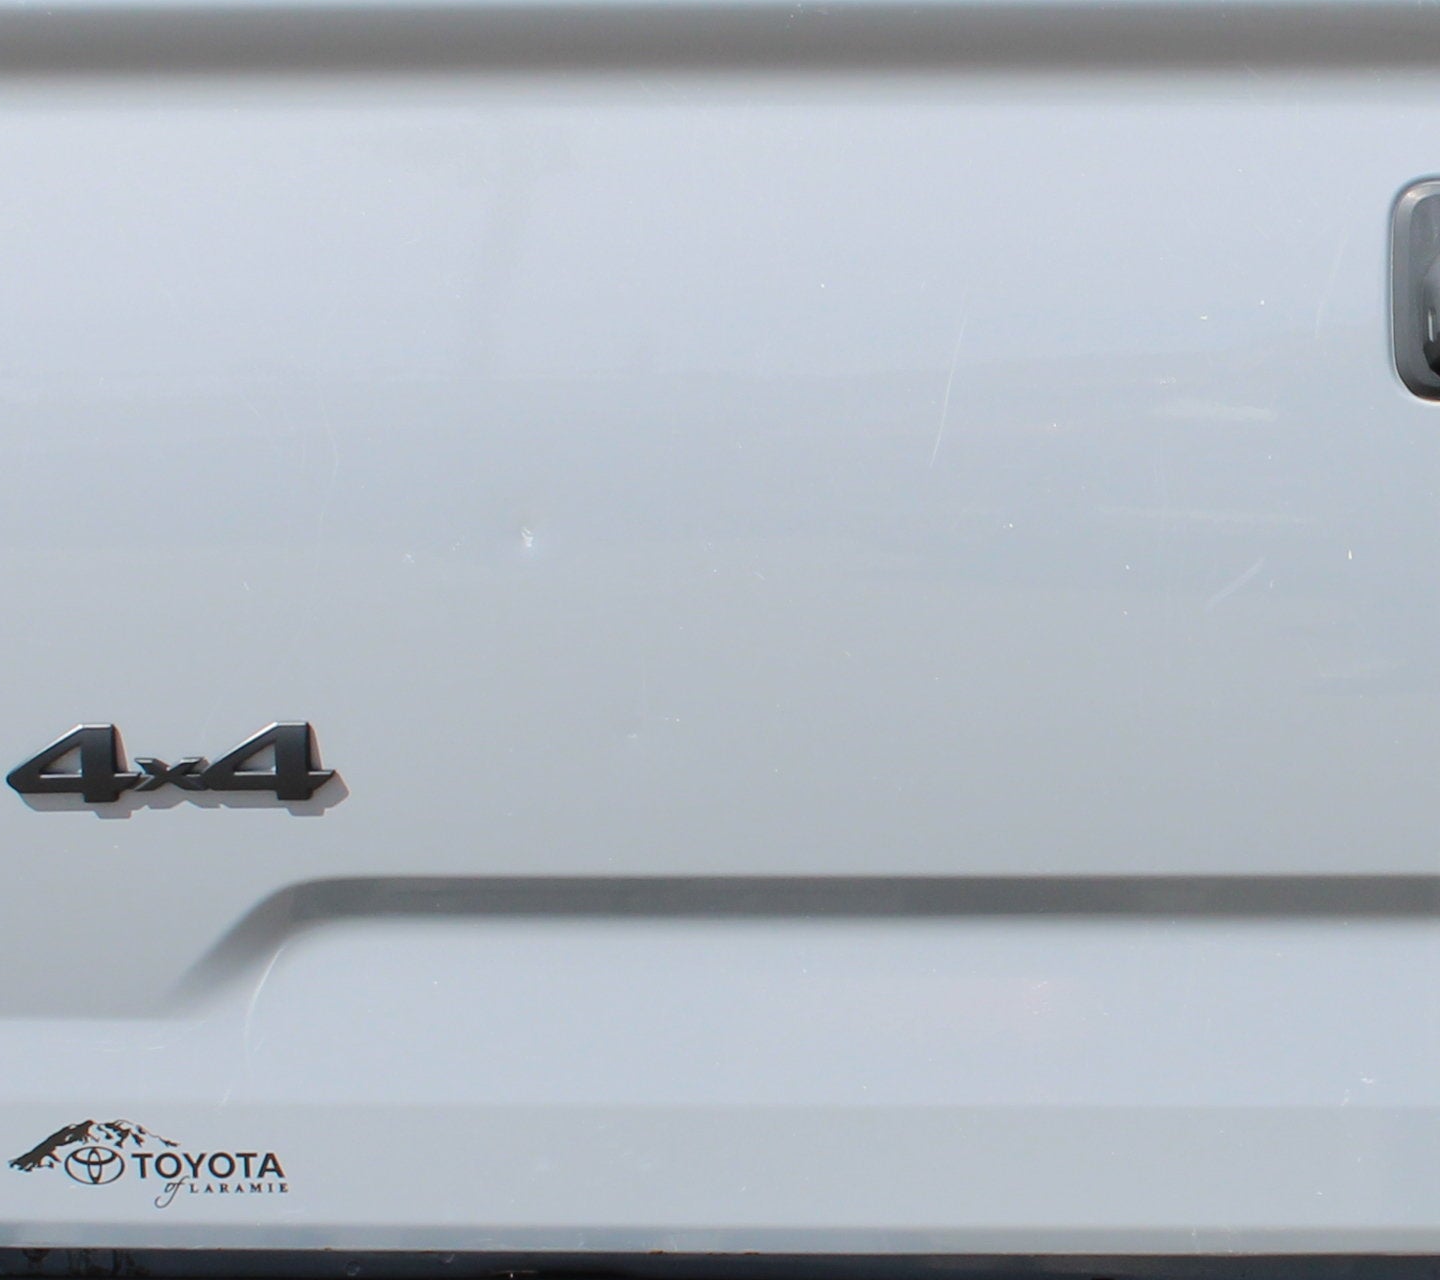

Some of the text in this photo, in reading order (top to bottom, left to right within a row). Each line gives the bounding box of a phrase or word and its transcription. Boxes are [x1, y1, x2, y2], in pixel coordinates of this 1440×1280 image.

[5, 720, 337, 804] 4x4
[131, 1151, 286, 1179] TOYOTA
[154, 1175, 289, 1209] of LARAMIE
